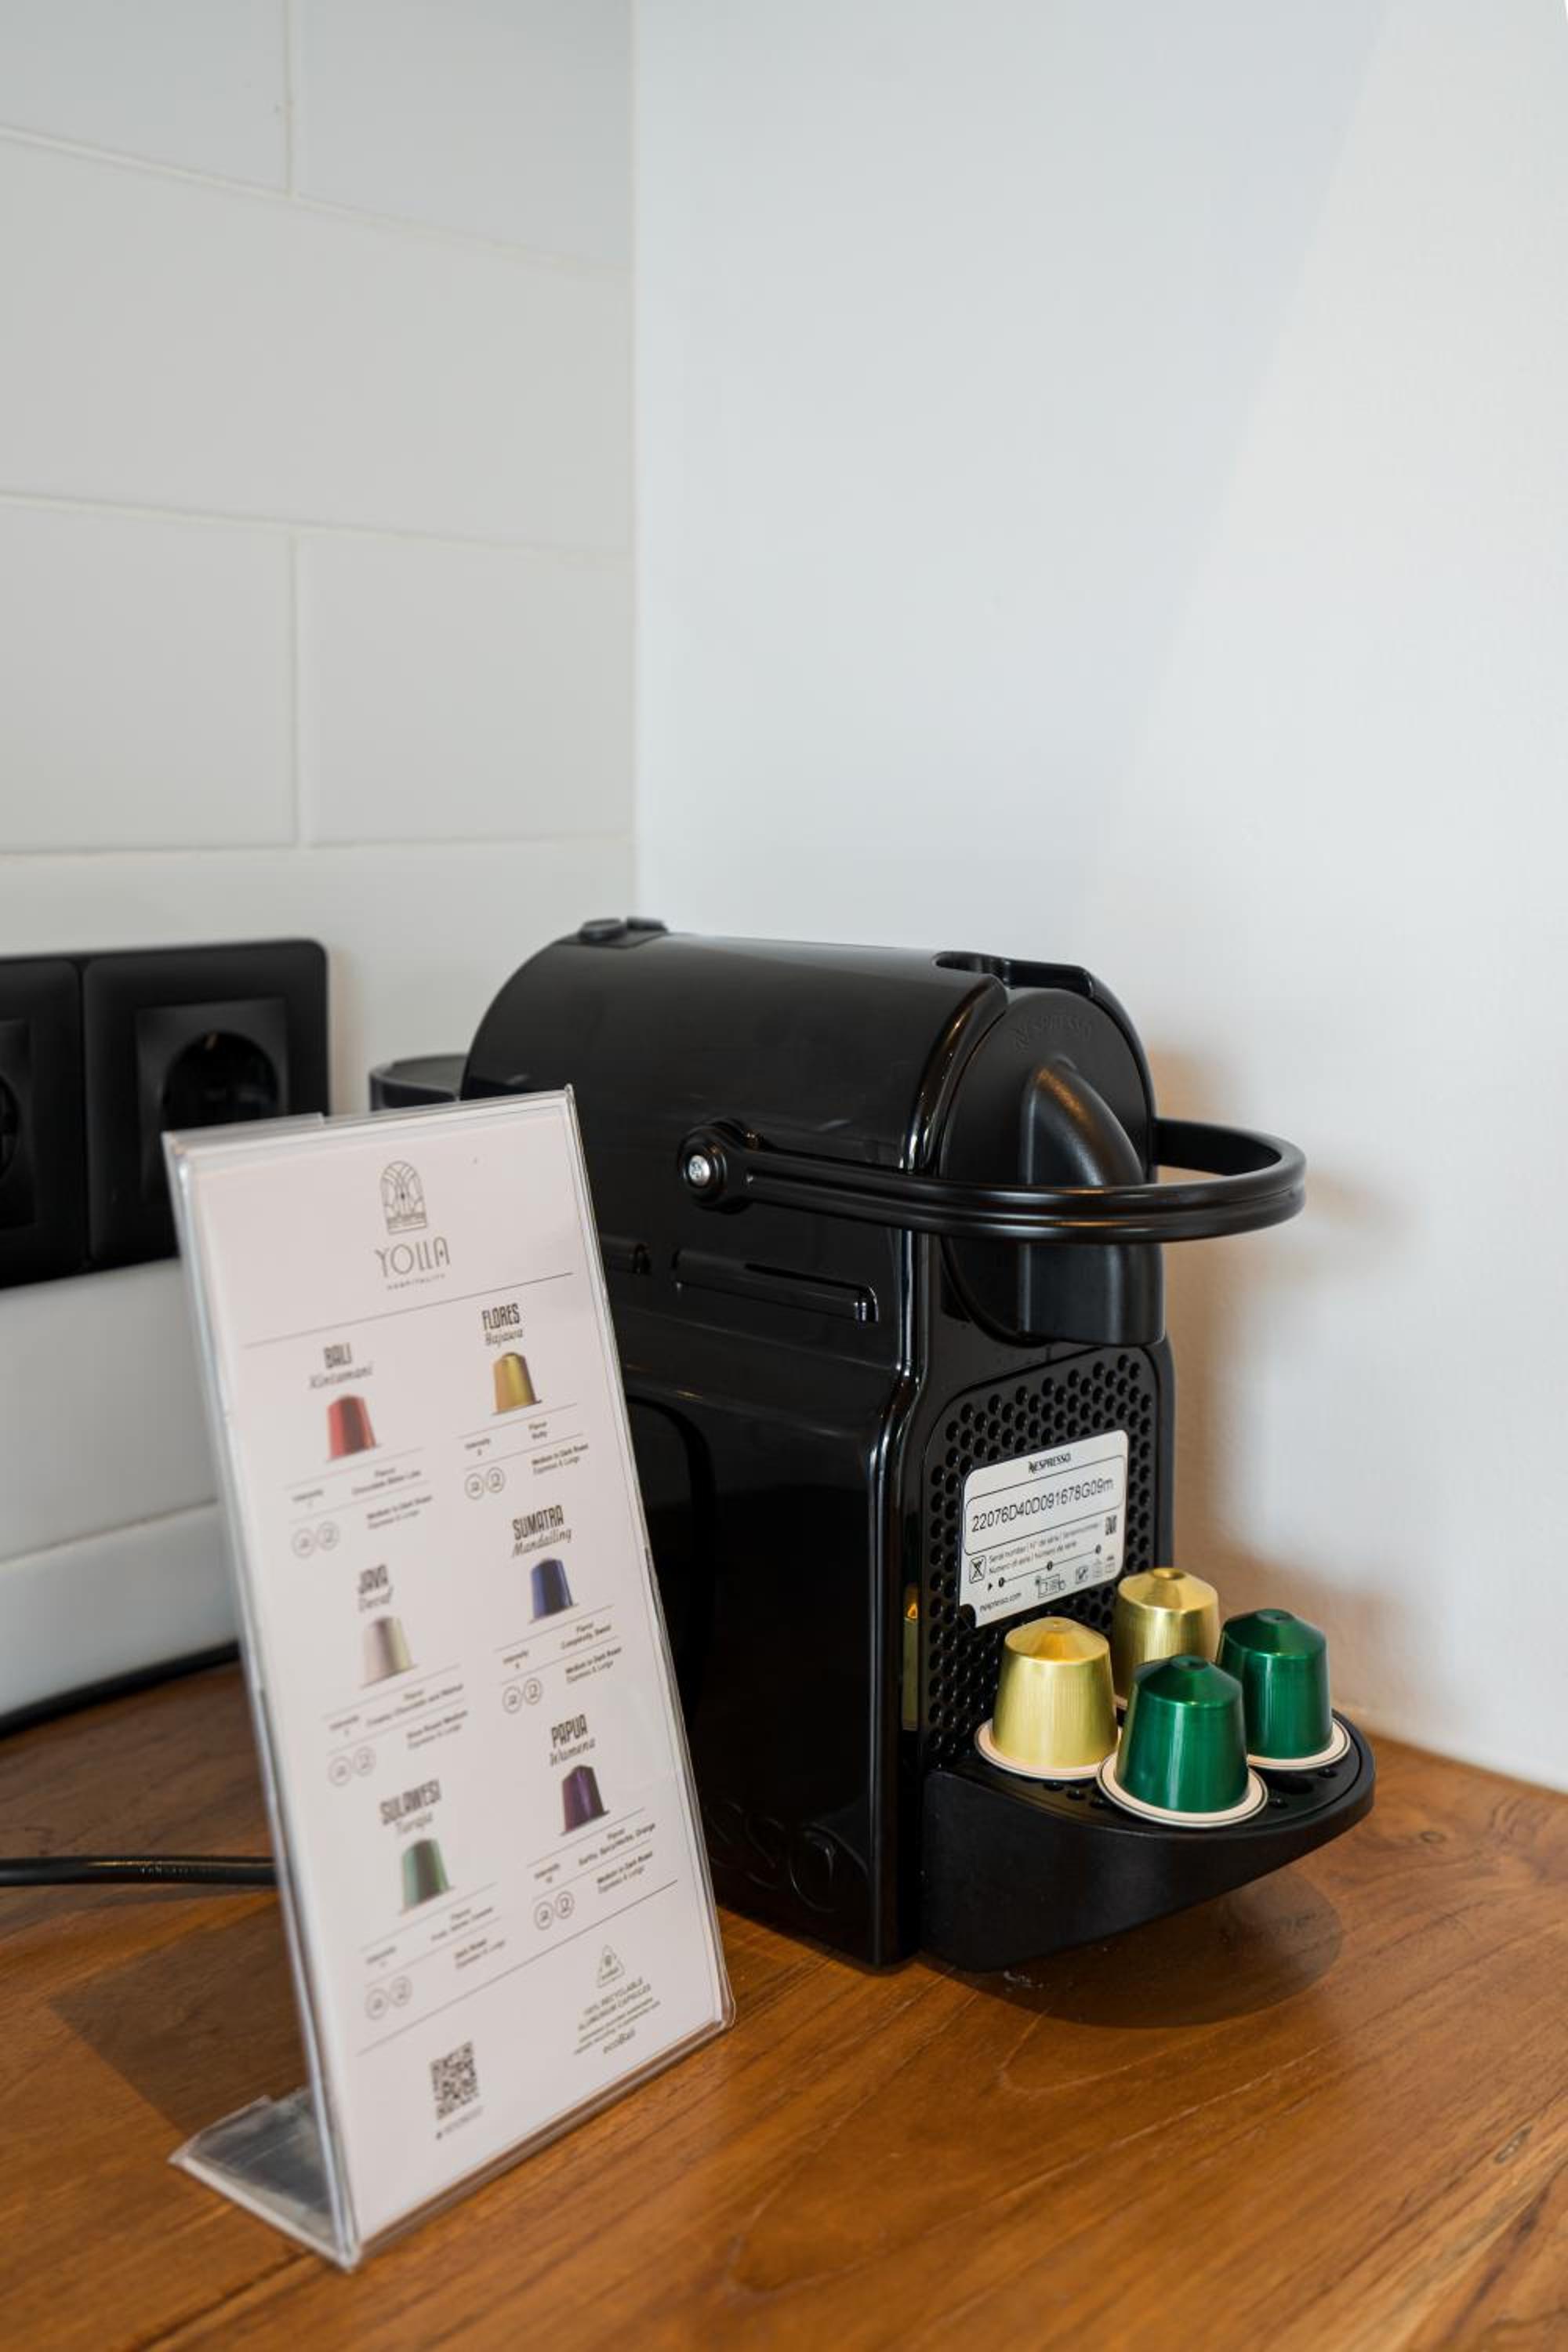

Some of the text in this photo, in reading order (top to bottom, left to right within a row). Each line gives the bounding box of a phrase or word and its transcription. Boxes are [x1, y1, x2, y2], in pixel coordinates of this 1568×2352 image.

[374, 1236, 451, 1278] YOLLA
[481, 1303, 521, 1330] FLORES
[323, 1341, 352, 1370] BALI
[512, 1505, 564, 1541] SUMATRA
[512, 1528, 572, 1556] Mandailing
[550, 1714, 589, 1749] PAPUA
